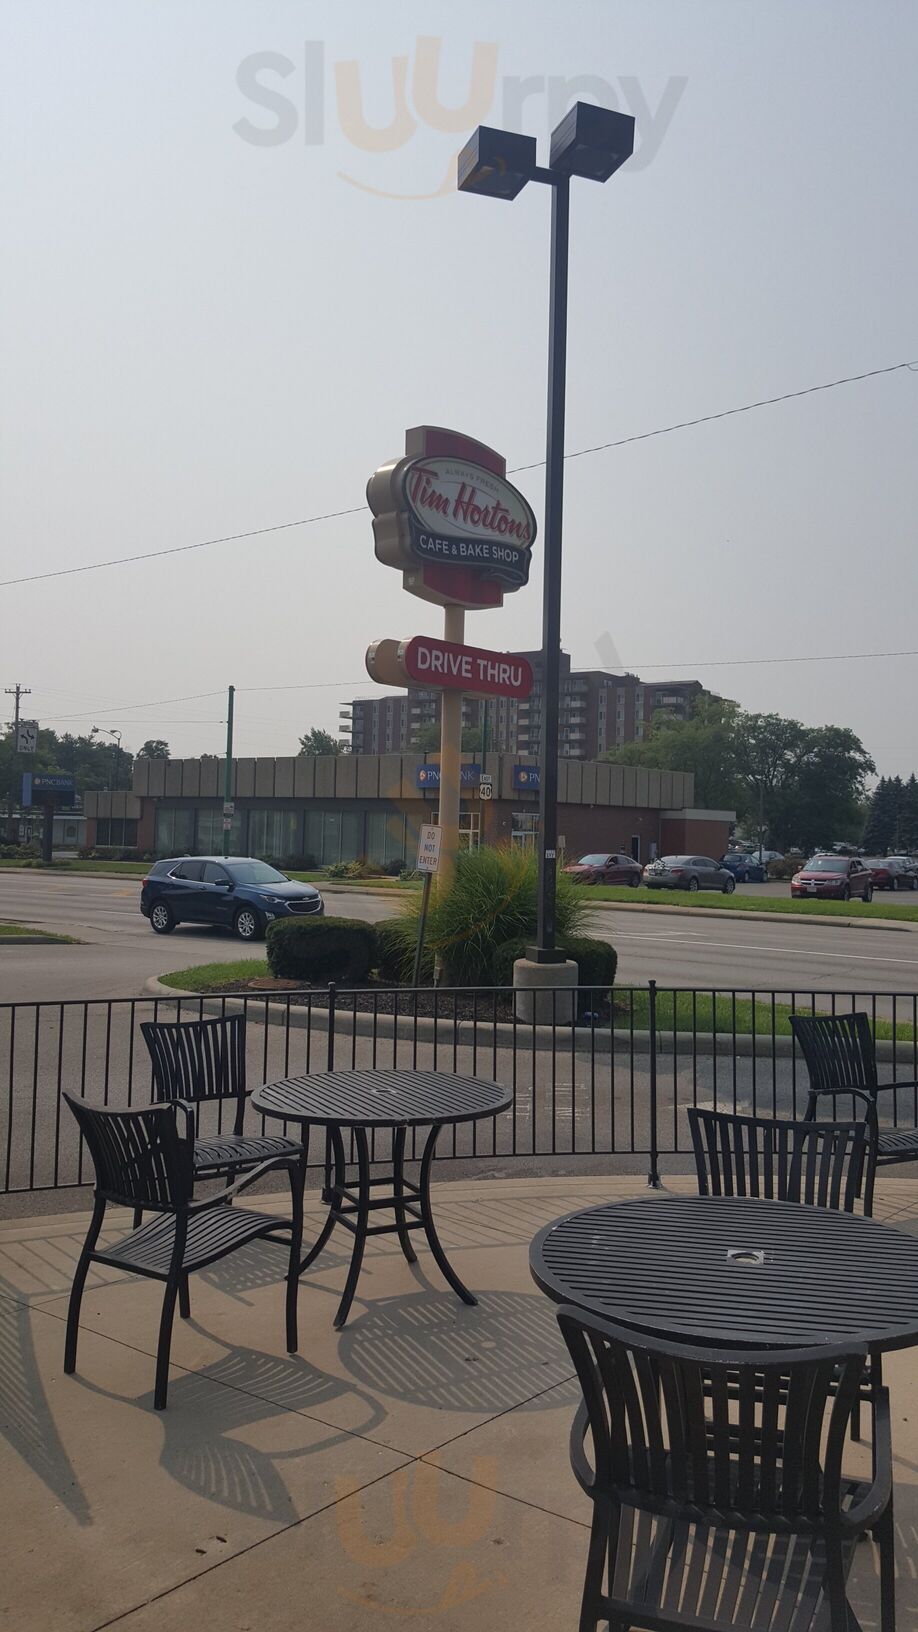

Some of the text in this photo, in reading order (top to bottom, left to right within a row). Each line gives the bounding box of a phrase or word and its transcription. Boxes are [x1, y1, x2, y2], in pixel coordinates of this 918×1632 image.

[410, 465, 531, 541] Tim Hortons
[419, 535, 519, 563] CAFE & BAKE SHOP
[417, 647, 523, 687] DRIVE THRU
[481, 786, 491, 798] 40
[427, 831, 436, 840] DO
[424, 843, 436, 853] NOT
[419, 856, 438, 866] ENTER
